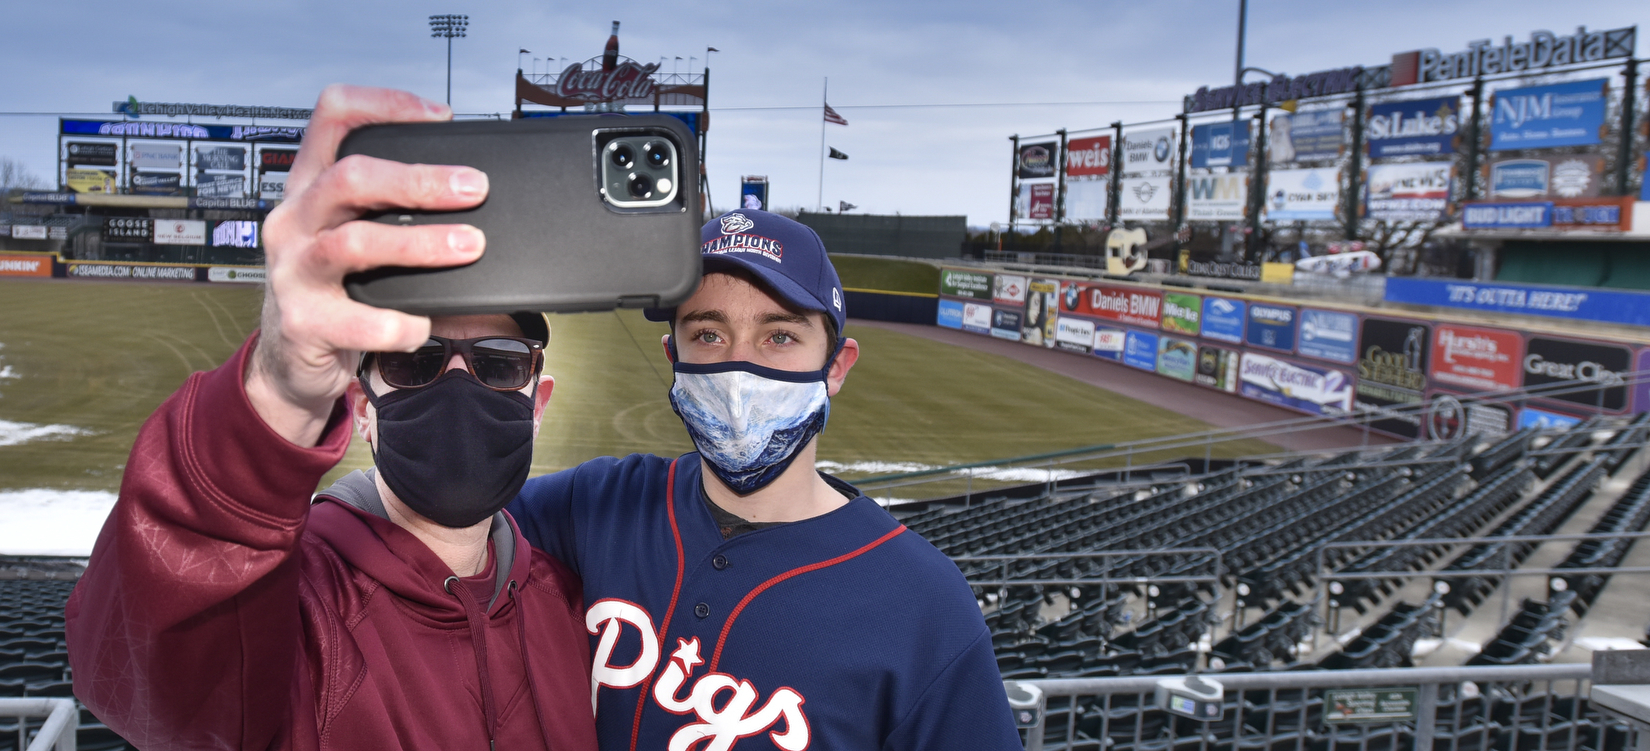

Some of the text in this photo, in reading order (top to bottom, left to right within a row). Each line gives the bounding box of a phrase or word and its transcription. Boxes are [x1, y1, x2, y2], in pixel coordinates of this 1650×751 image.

[1418, 28, 1607, 83] PenTeleData
[141, 102, 314, 120] Lehigh Valley Health Netwo
[1496, 93, 1553, 128] NJM
[1127, 139, 1153, 150] Daniels
[262, 152, 297, 165] GIAN
[1068, 142, 1109, 169] weis
[1129, 152, 1149, 162] BMW
[262, 182, 284, 192] ESS
[1192, 177, 1240, 200] WM
[196, 198, 227, 208] Capital
[108, 218, 149, 228] GOOSE
[1466, 205, 1546, 225] BUD LIGHT
[108, 229, 149, 238] ISLAND
[701, 233, 783, 258] HAMPIONS
[132, 266, 157, 278] ONLINE
[157, 267, 194, 280] MARKETING
[1092, 288, 1161, 318] Daniels BMW
[1478, 287, 1527, 308] OUTTA
[1165, 301, 1185, 318] Mike
[1252, 306, 1293, 322] OLYMPUS
[1244, 359, 1279, 380] SERVICE
[1279, 367, 1319, 389] ELECTRIC
[1523, 353, 1576, 379] Great
[585, 597, 812, 751] Pigs
